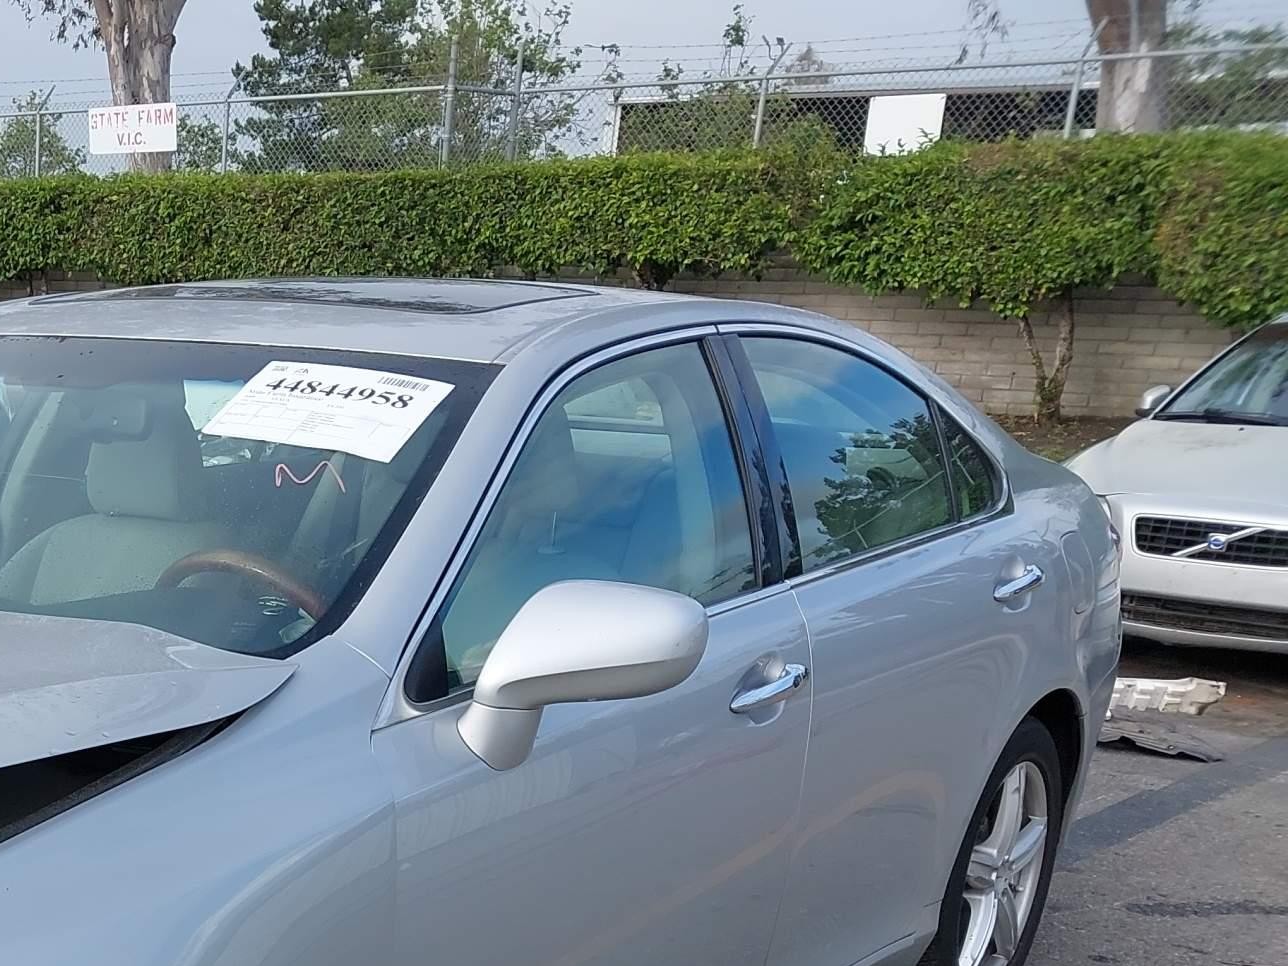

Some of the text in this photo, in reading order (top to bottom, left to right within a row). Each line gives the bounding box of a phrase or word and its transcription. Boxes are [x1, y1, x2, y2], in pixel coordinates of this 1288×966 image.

[91, 107, 174, 129] STATE FARM
[117, 132, 146, 146] V.I.C.
[265, 377, 415, 409] 44844958
